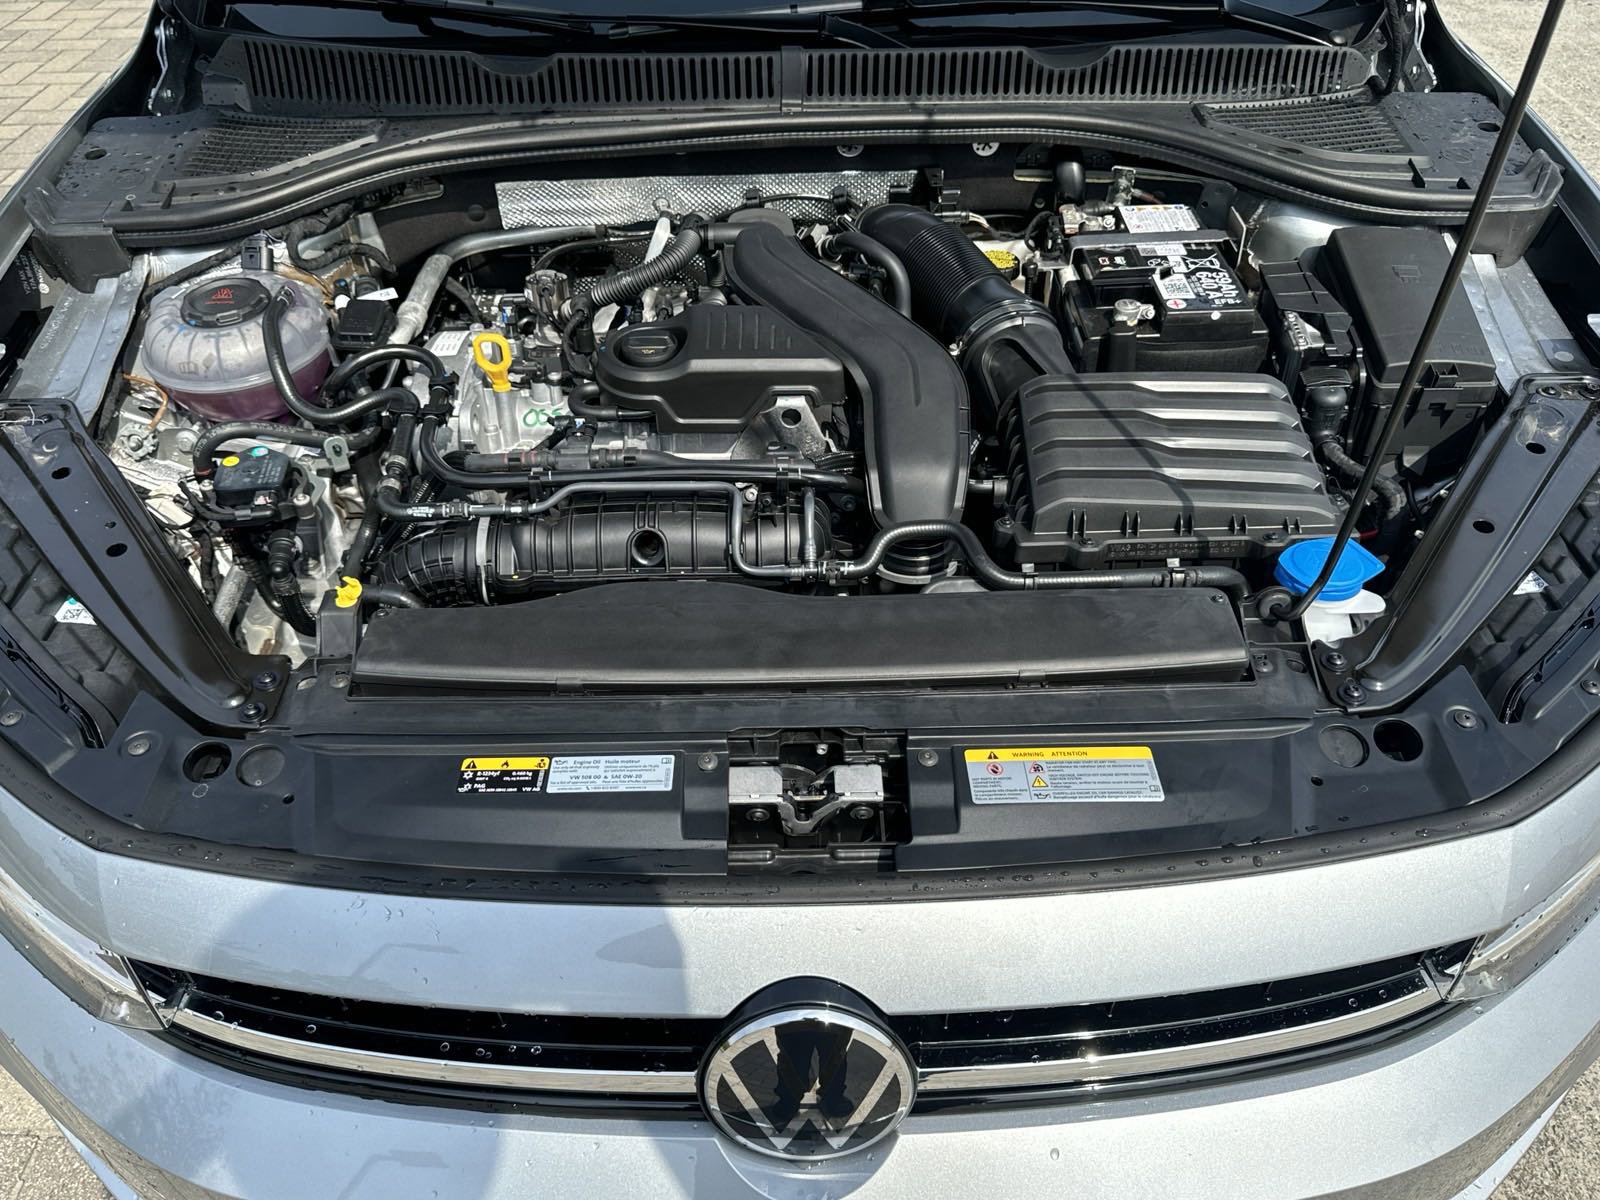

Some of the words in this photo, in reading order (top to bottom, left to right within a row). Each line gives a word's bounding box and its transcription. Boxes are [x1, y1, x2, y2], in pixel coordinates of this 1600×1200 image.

[1195, 271, 1219, 289] 640
[1212, 271, 1239, 297] 59Ah
[1205, 290, 1224, 300] A
